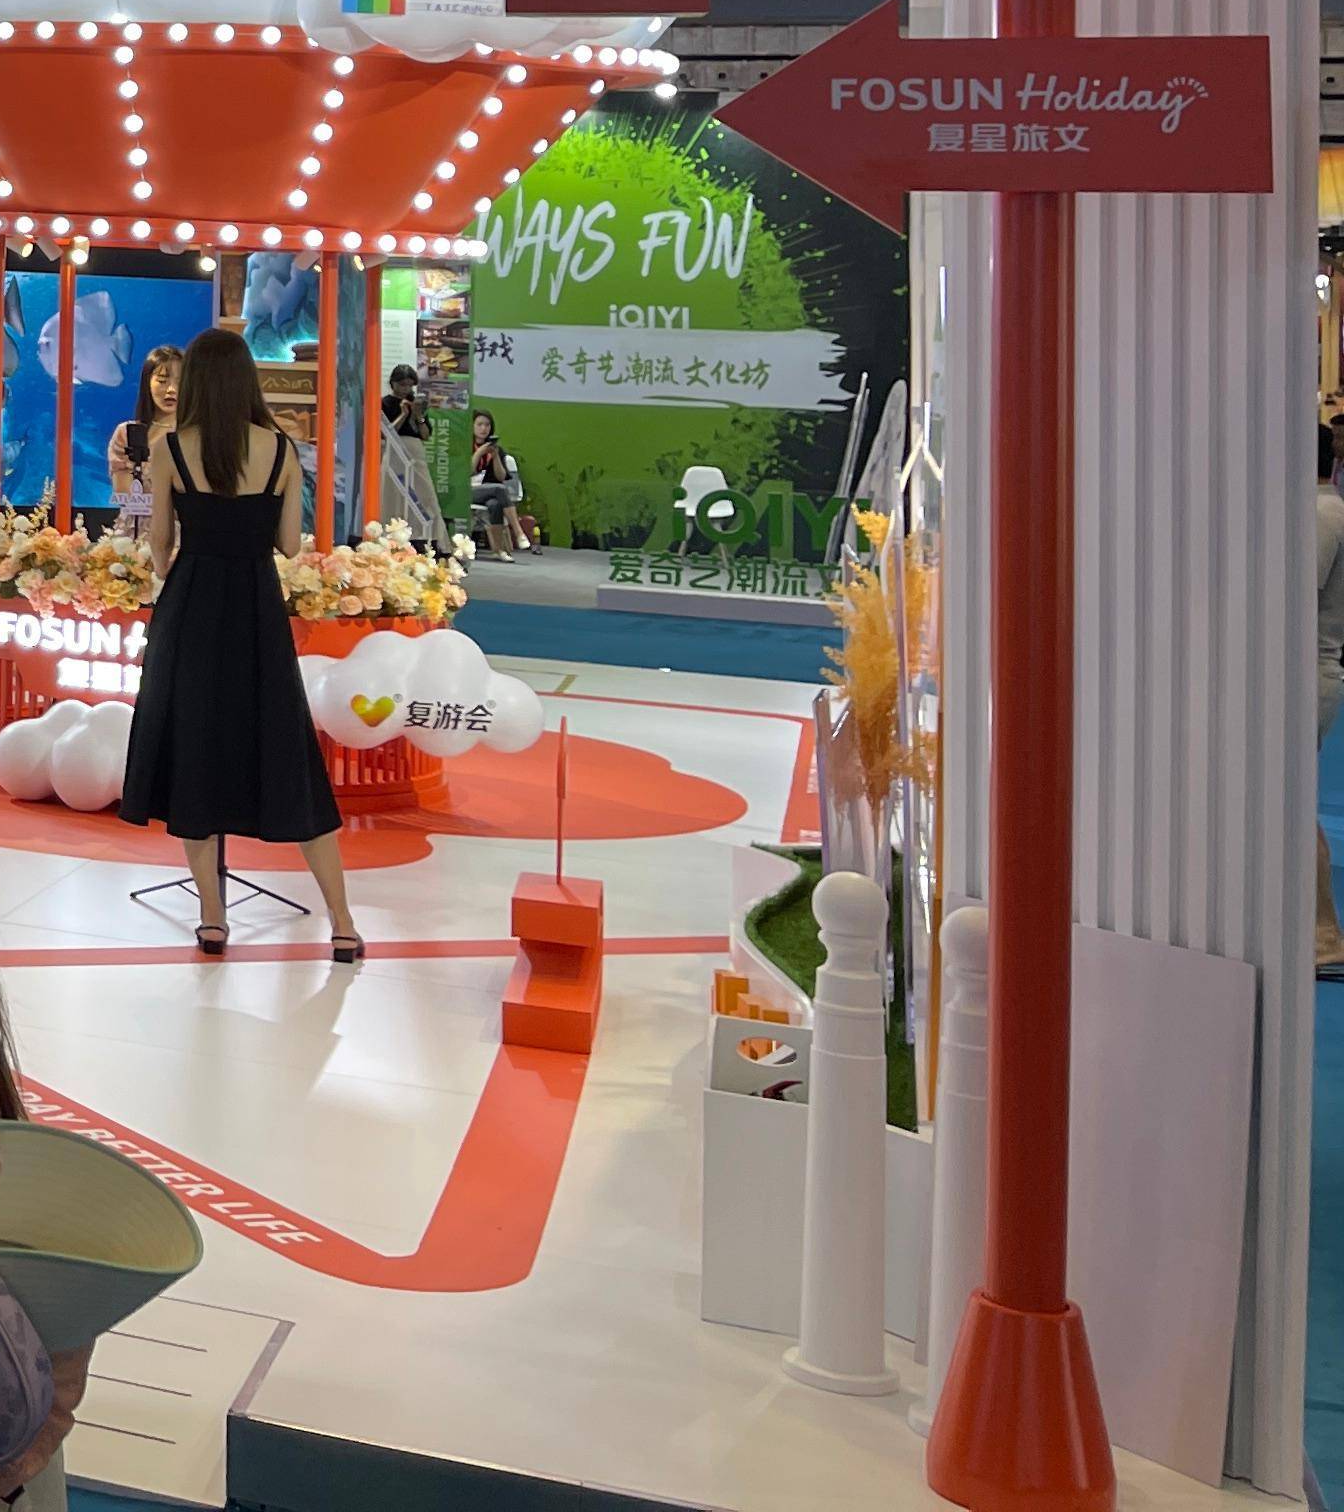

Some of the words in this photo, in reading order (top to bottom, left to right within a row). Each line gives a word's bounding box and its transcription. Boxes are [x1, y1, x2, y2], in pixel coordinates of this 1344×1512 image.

[829, 77, 1004, 112] FOSUN
[1015, 72, 1196, 134] Holiday
[927, 122, 1091, 153] 复星旅文
[638, 193, 754, 282] FUN
[609, 303, 690, 329] iQIYI
[540, 346, 772, 391] 爱奇艺潮流文化坊
[608, 546, 857, 598] 爱奇艺潮流文
[403, 699, 495, 733] 复游会
[71, 1128, 225, 1198] BETTER
[208, 1201, 323, 1245] LIFE
